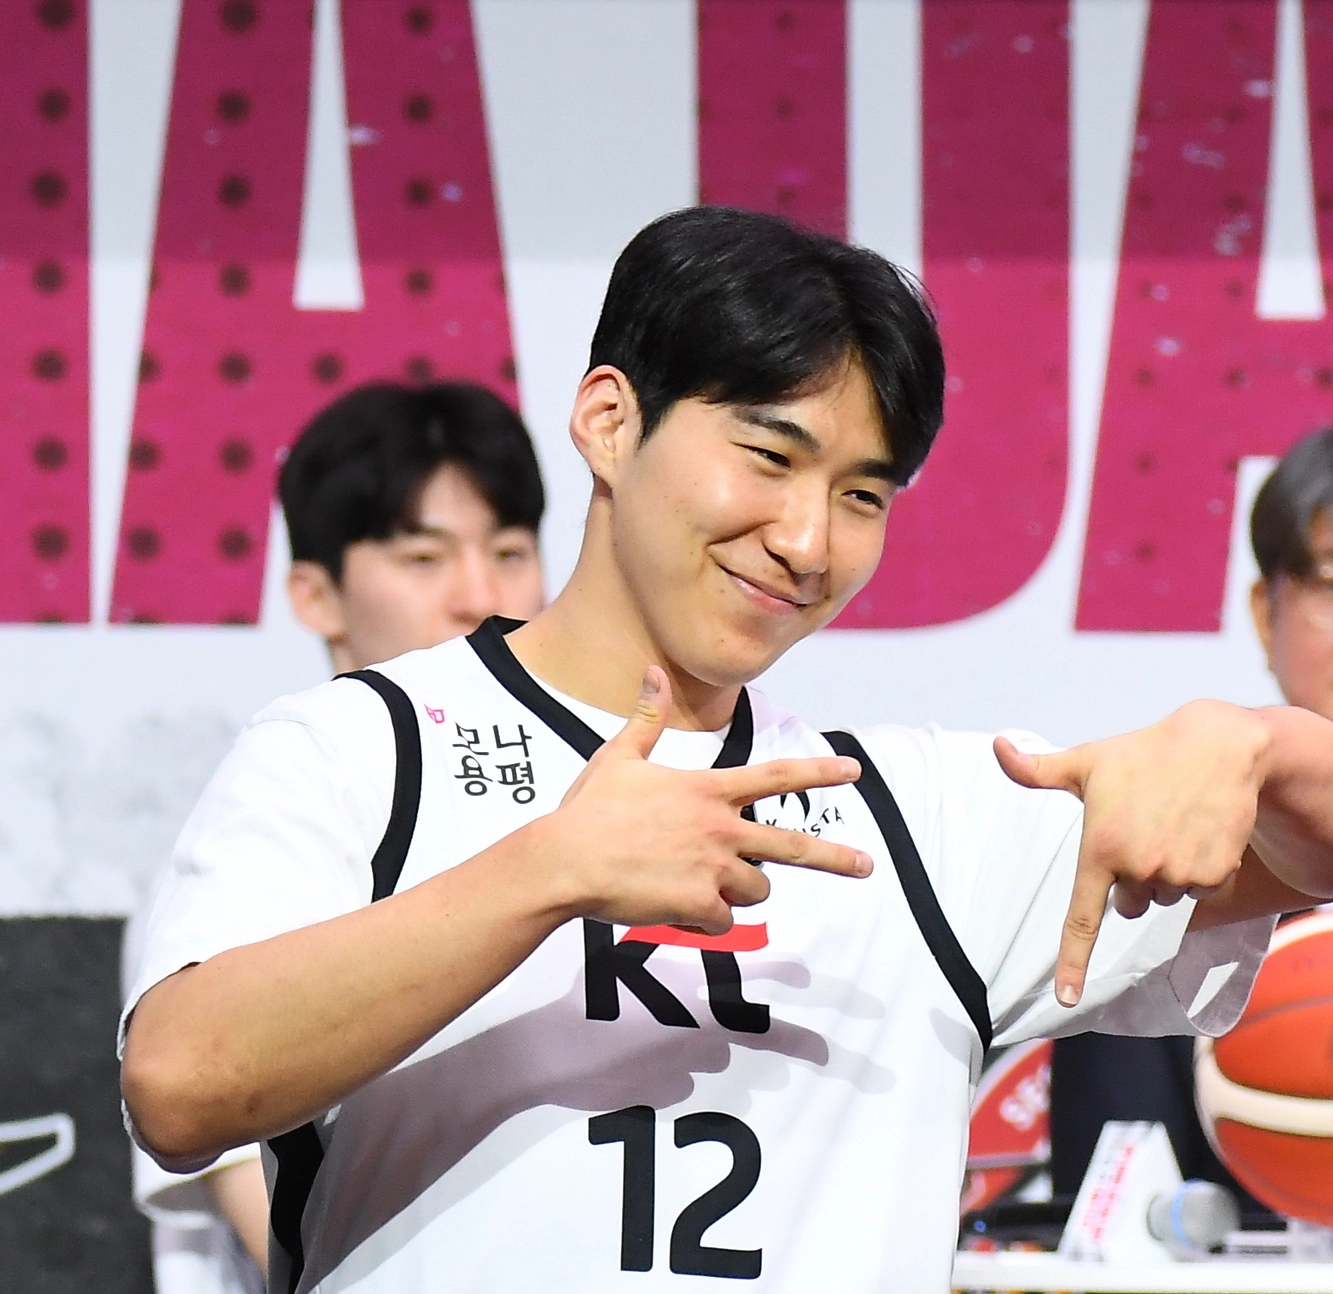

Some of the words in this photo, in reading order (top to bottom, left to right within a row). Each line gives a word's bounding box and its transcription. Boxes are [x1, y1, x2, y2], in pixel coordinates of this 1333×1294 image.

[452, 721, 533, 758] 모나
[453, 755, 536, 804] 용평
[583, 917, 770, 1033] kt
[588, 1105, 763, 1279] 12
